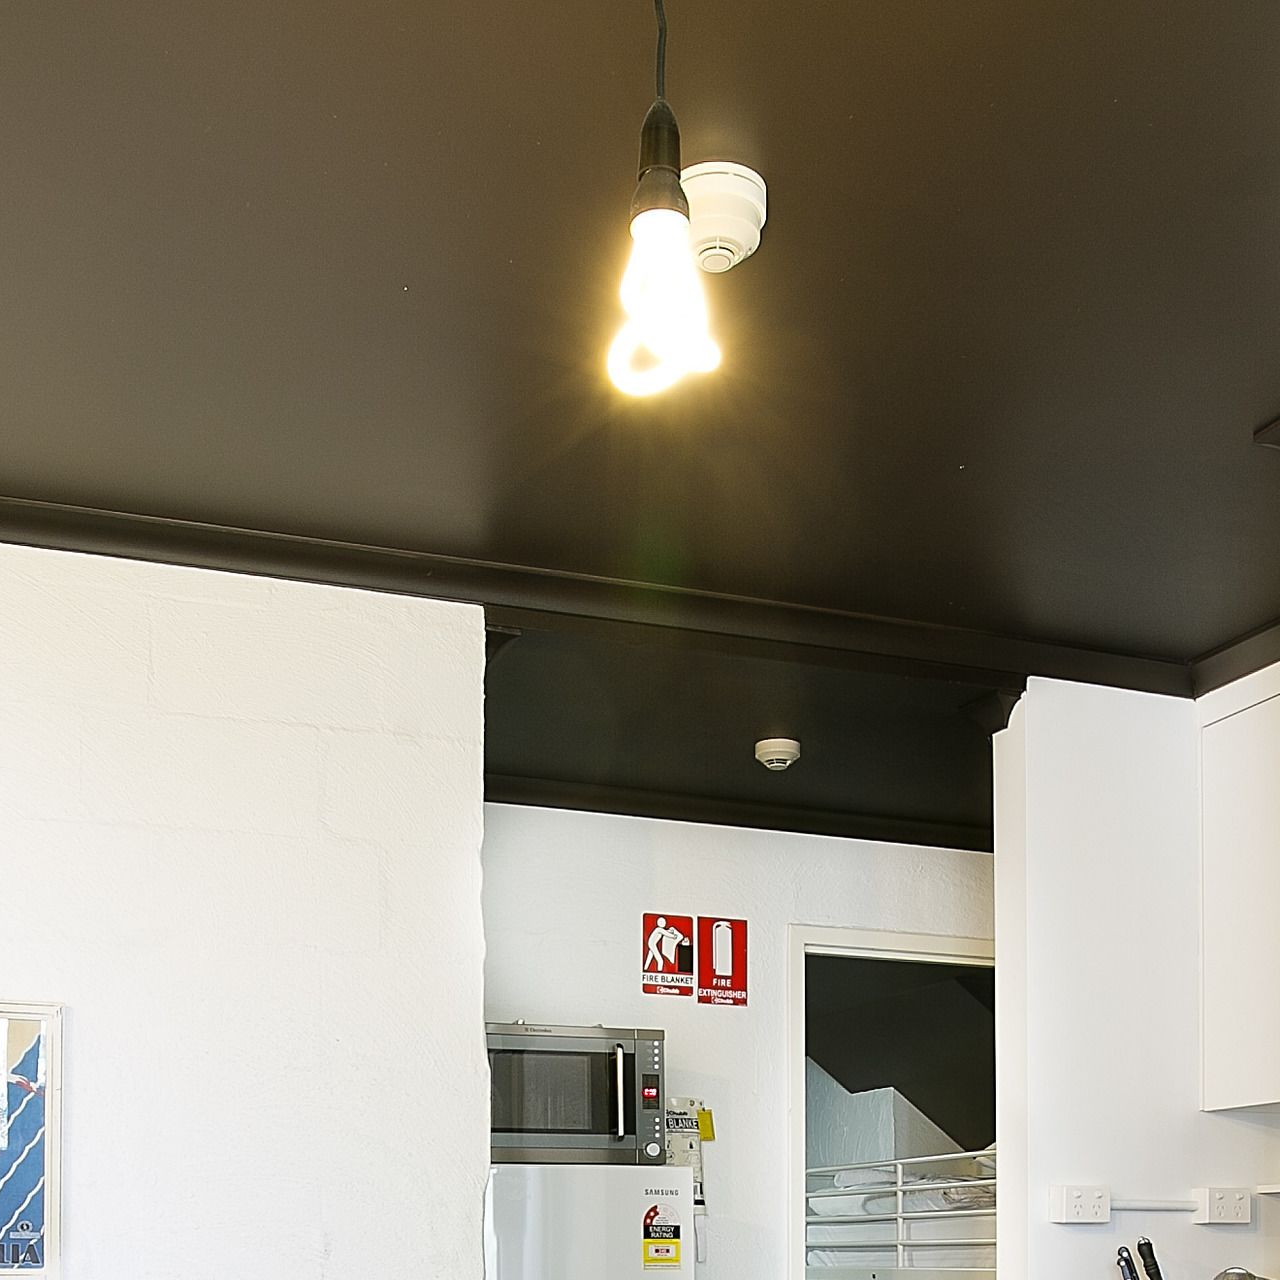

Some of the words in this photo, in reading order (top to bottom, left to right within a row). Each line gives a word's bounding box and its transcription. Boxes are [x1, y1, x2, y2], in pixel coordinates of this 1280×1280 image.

[642, 974, 659, 983] FIRE
[661, 975, 693, 985] BLANKET
[712, 978, 732, 987] FIRE
[698, 988, 747, 999] EXTINGUISHER
[668, 1118, 698, 1129] BLANKE
